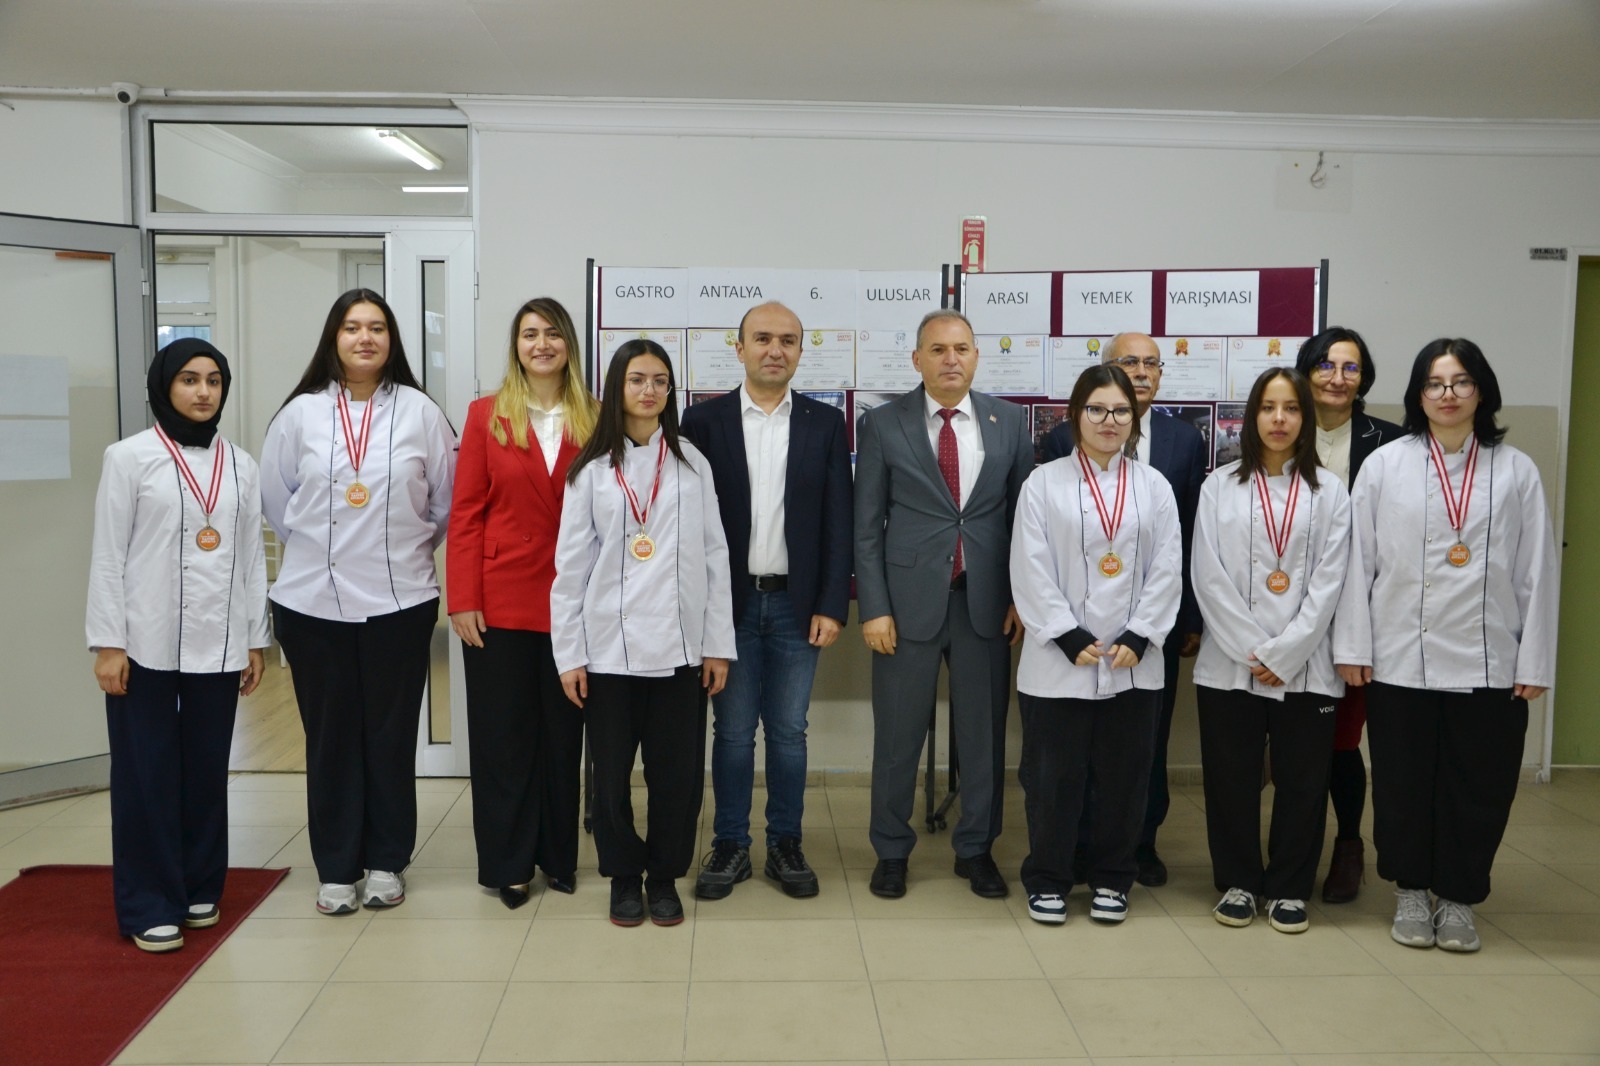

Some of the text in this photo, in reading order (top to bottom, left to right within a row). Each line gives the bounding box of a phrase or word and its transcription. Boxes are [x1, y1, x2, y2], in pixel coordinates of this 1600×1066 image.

[614, 285, 1252, 308] GASTRO ANTALYA 6. ULUSLAR ARASI YEMEK YARIŞMASI
